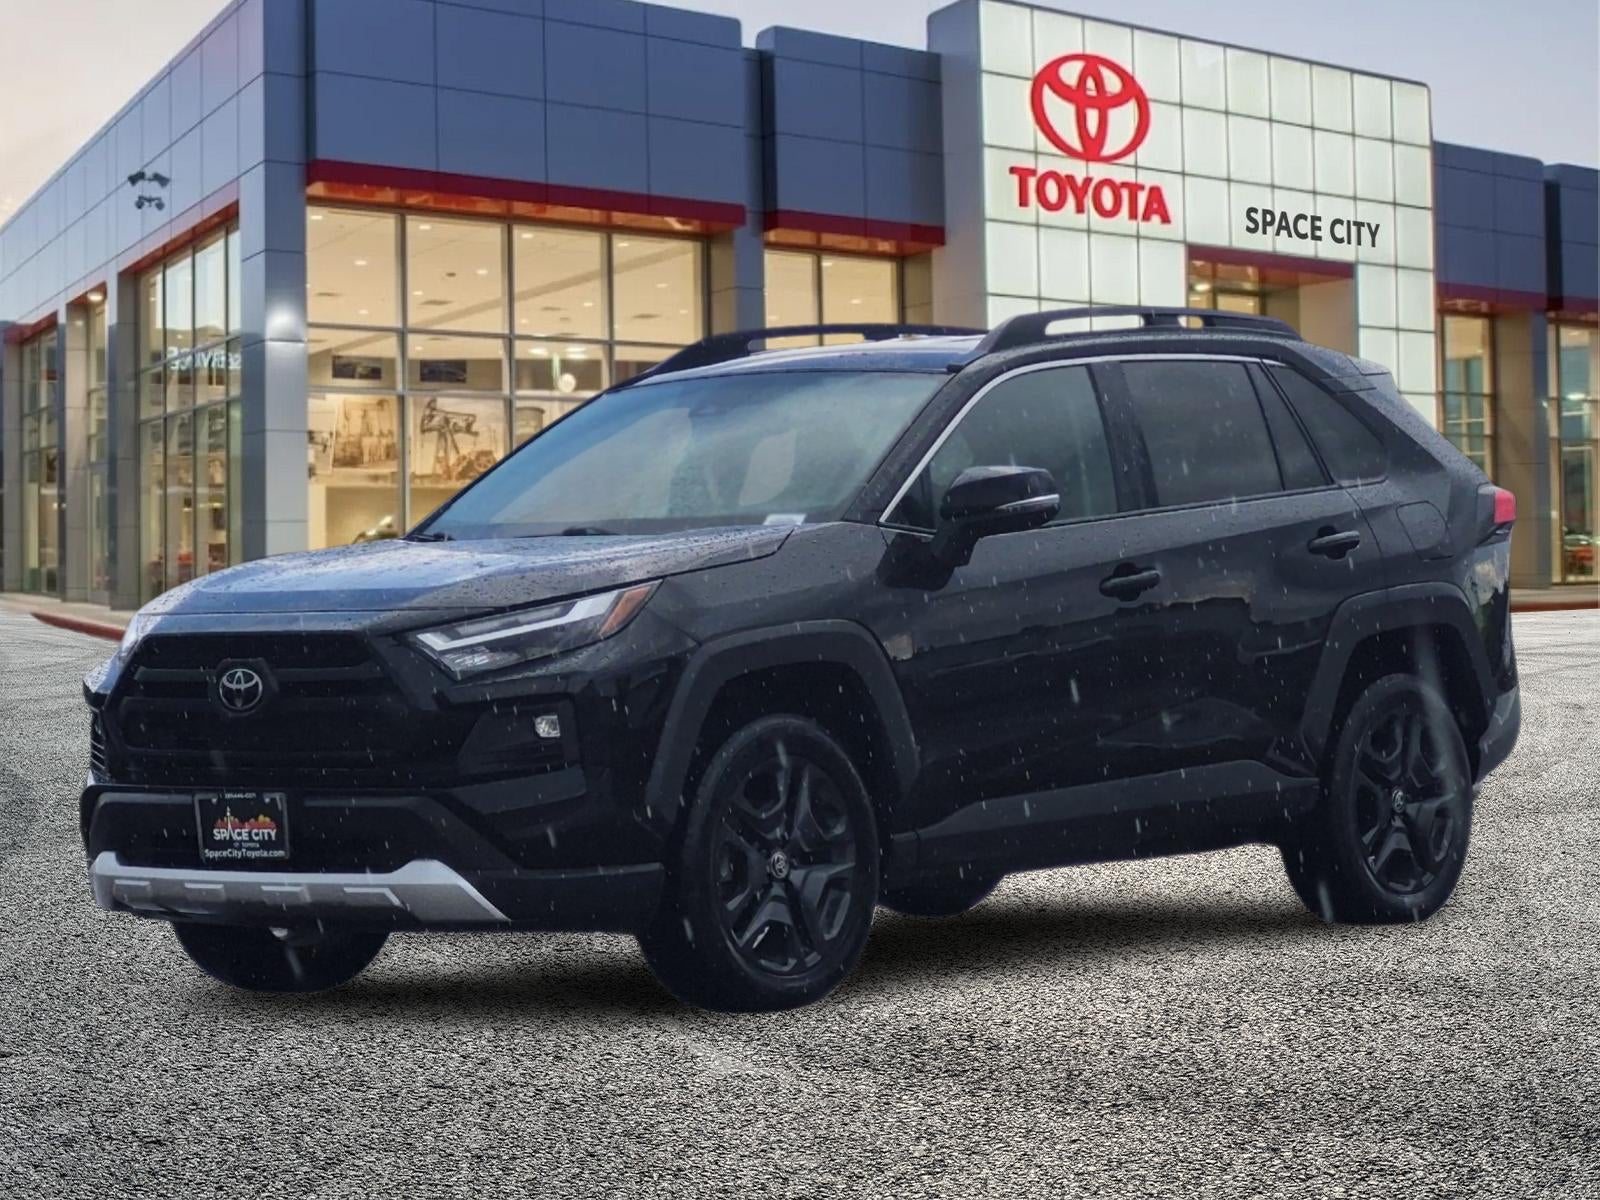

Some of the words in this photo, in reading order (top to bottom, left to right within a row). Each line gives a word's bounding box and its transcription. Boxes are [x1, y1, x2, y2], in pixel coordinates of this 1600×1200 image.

[1008, 166, 1171, 224] TOYOTA
[1245, 207, 1322, 241] SPACE
[1329, 218, 1380, 247] CITY
[213, 829, 249, 840] SPACE
[251, 829, 276, 840] CITY
[204, 849, 285, 859] SpaceCityToyota.com
